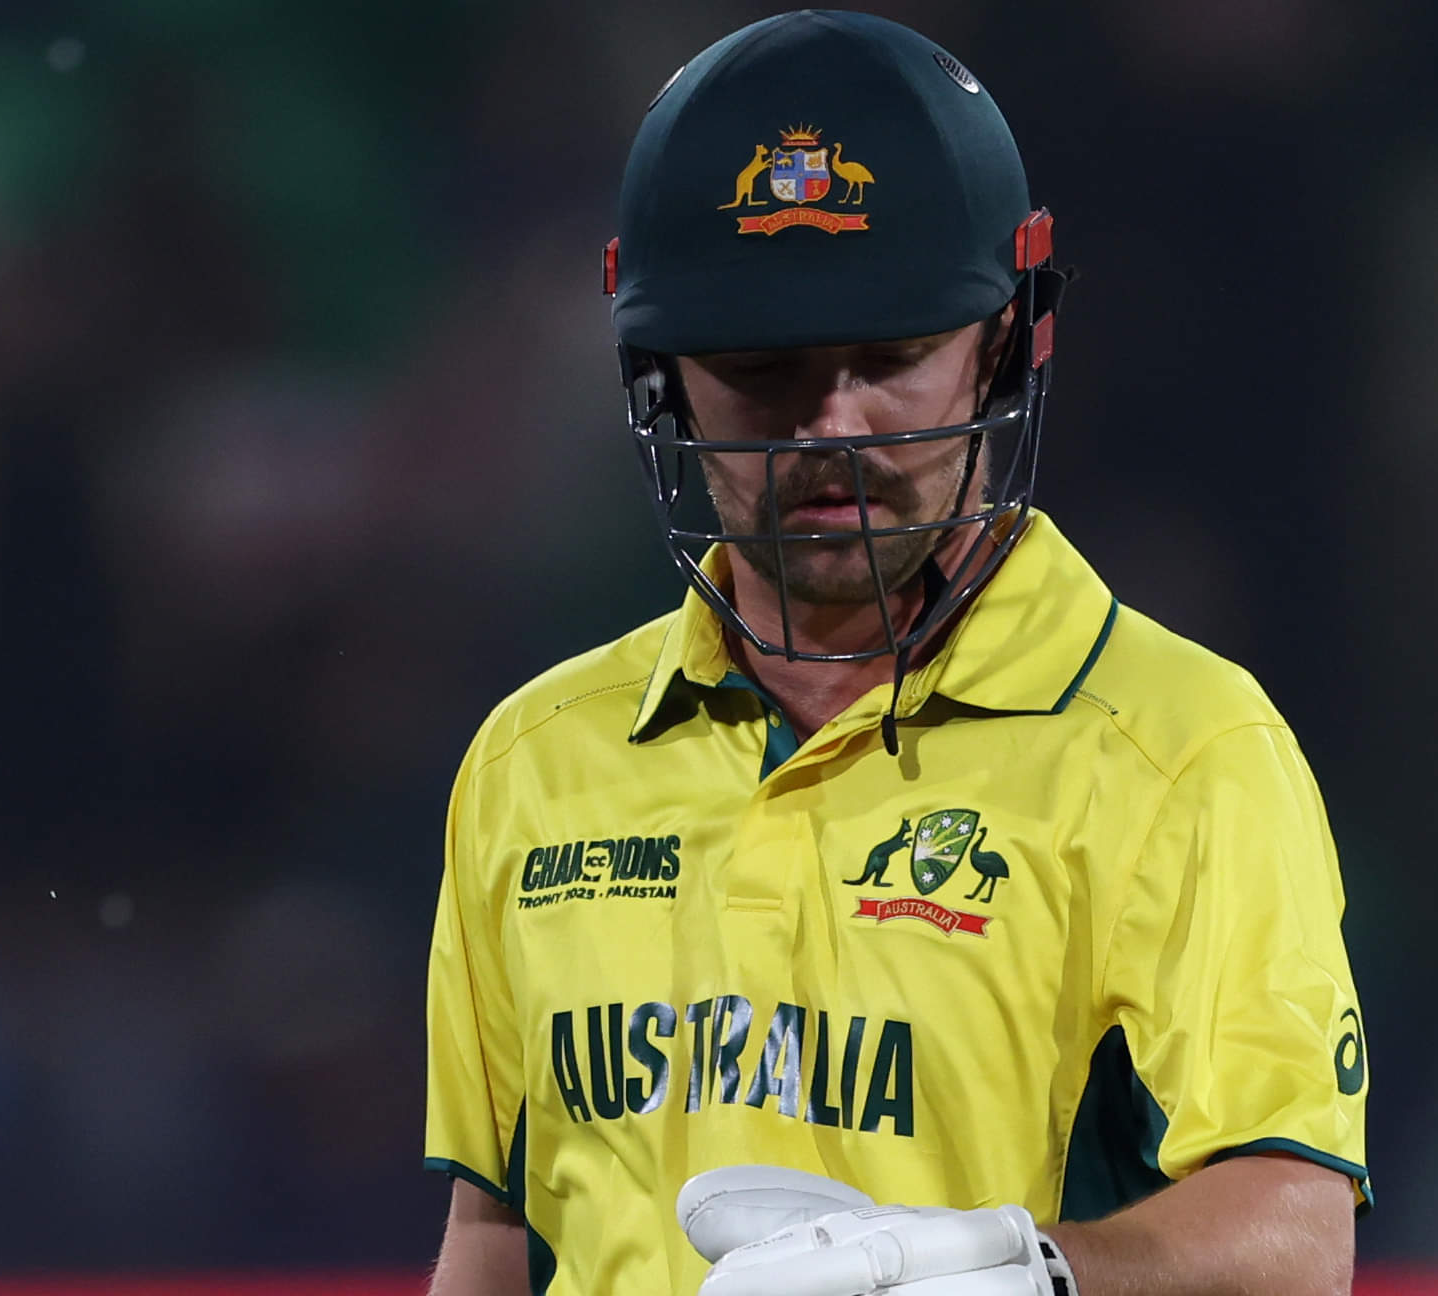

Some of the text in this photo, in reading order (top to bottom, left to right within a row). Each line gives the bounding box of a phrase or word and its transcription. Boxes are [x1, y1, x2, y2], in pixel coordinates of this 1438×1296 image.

[584, 855, 607, 868] ICC
[518, 885, 677, 909] TROPHY 2025 PAKISTAN
[884, 902, 953, 928] AUSTRALIA
[551, 994, 915, 1137] AUSTRALIA
